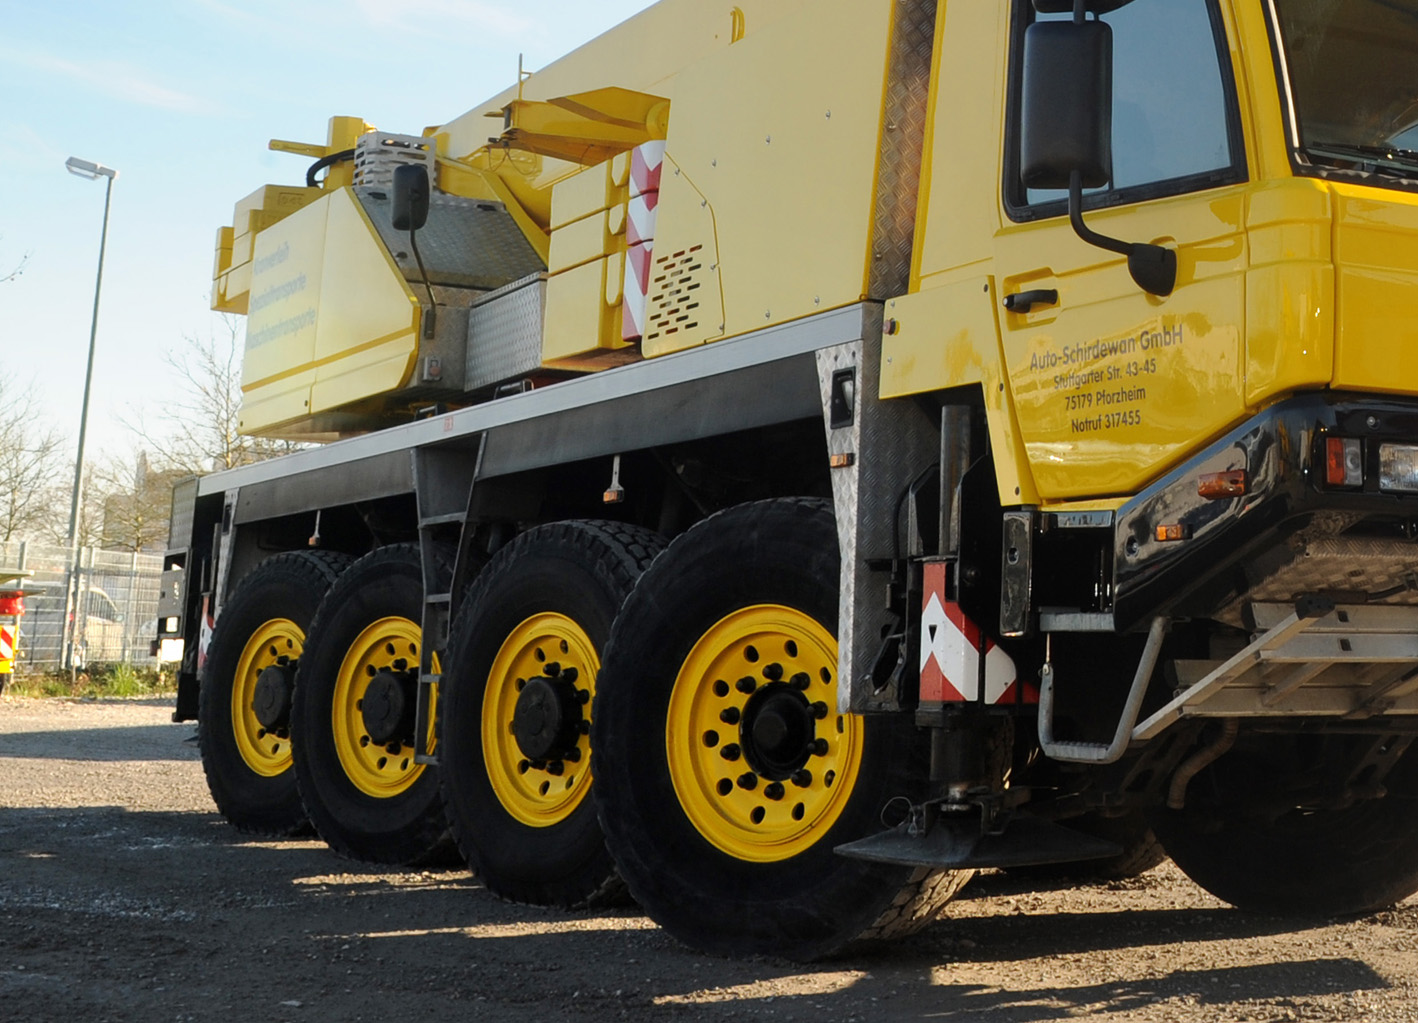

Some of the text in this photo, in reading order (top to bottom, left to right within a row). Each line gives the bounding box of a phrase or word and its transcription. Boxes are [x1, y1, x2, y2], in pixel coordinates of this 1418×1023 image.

[1030, 324, 1183, 371] Auto-Schirdewan GmbH
[1054, 359, 1157, 390] Stuttgarter Str. 43-45
[1065, 386, 1147, 411] 75179 Pforzheim
[1071, 410, 1141, 433] Notruf 317455
